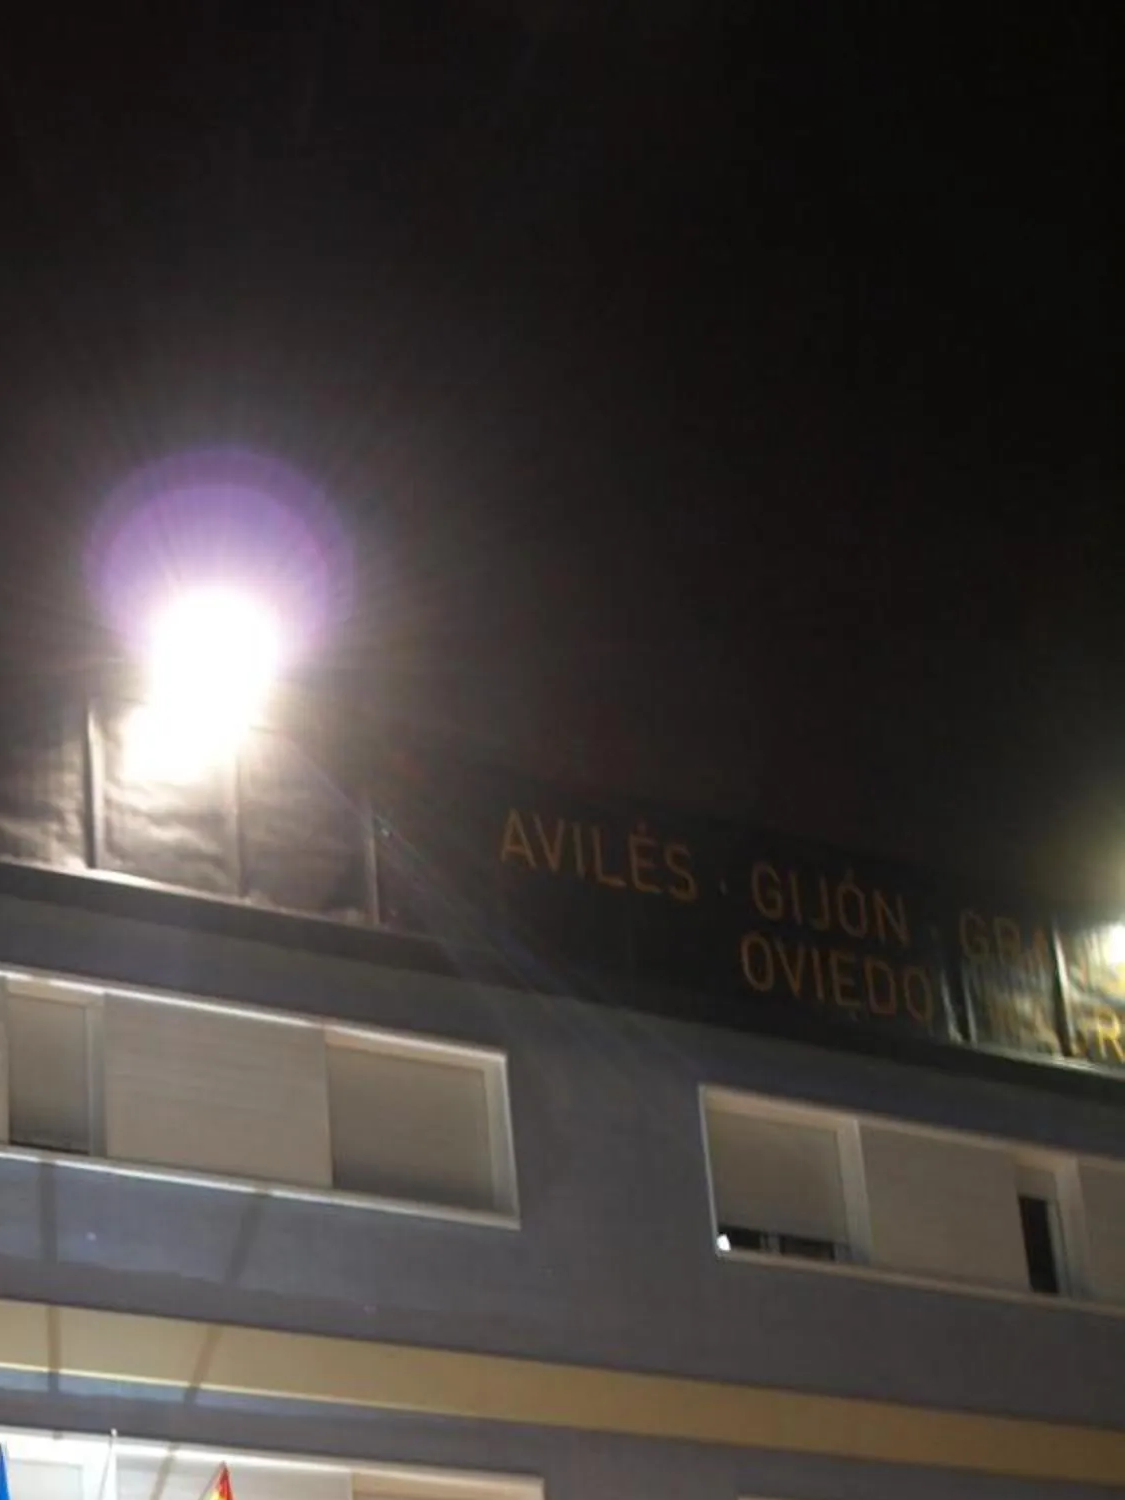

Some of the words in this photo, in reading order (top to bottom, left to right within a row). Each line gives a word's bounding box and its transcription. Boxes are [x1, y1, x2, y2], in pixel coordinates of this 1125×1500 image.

[499, 808, 699, 904] AVILÉS
[749, 859, 912, 949] GIJÓN
[740, 931, 934, 1026] OVIEDO
